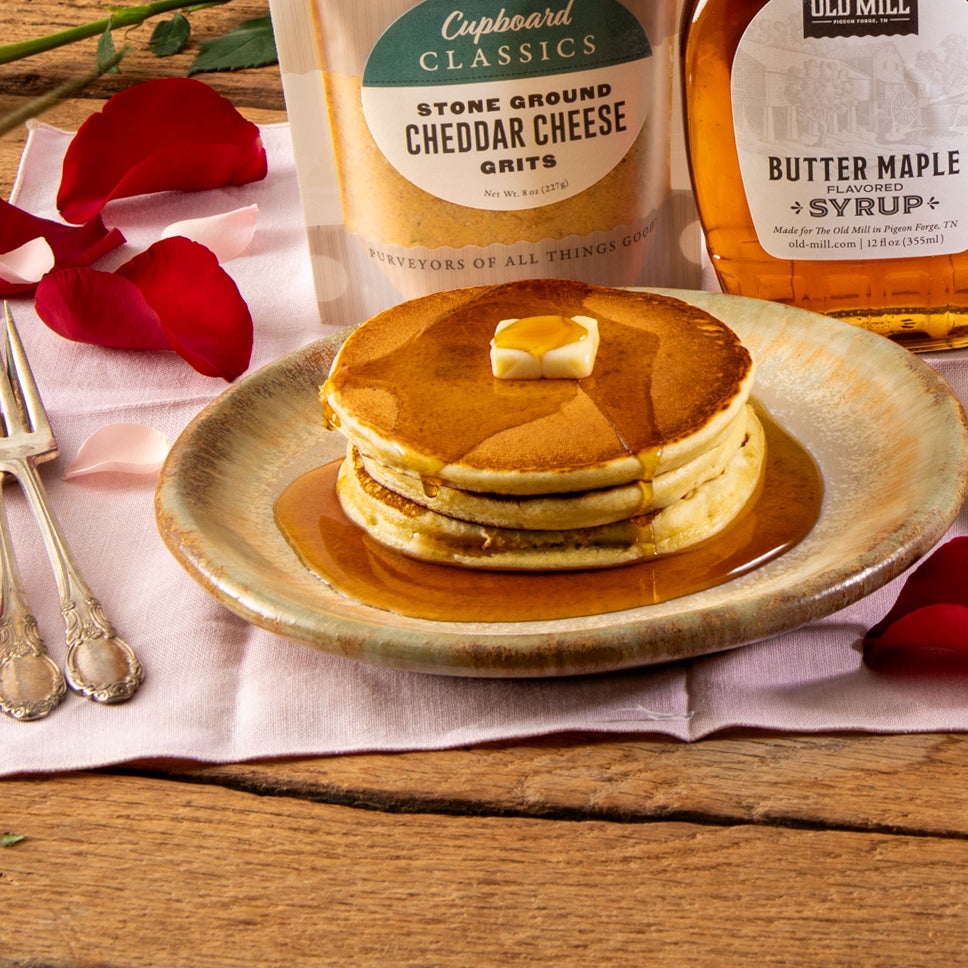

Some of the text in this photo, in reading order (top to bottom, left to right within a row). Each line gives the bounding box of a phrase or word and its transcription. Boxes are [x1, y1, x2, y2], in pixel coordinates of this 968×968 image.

[441, 0, 574, 44] Cupboard
[419, 34, 597, 71] CLASSICS
[417, 83, 612, 116] STONE GROUND
[406, 101, 627, 155] CHEDDAR CHEESE
[480, 154, 557, 174] GRITS
[768, 150, 960, 182] BUTTER MAPLE
[484, 190, 500, 198] Net
[504, 189, 520, 198] Wt.
[541, 179, 569, 194] (227g)
[827, 183, 904, 194] FLAVORED
[809, 195, 923, 218] SYRUP
[773, 226, 799, 234] Made
[799, 227, 813, 236] for
[851, 226, 870, 234] Mill
[884, 225, 912, 235] Pigeon
[915, 223, 940, 232] Forge,
[943, 220, 958, 229] TN
[789, 239, 856, 249] old-mill.com
[867, 239, 878, 247] 12
[902, 234, 944, 247] (355ml)
[369, 248, 465, 270] PURVEYORS
[474, 257, 496, 268] OF
[506, 254, 538, 266] ALL
[546, 241, 616, 262] THINGS
